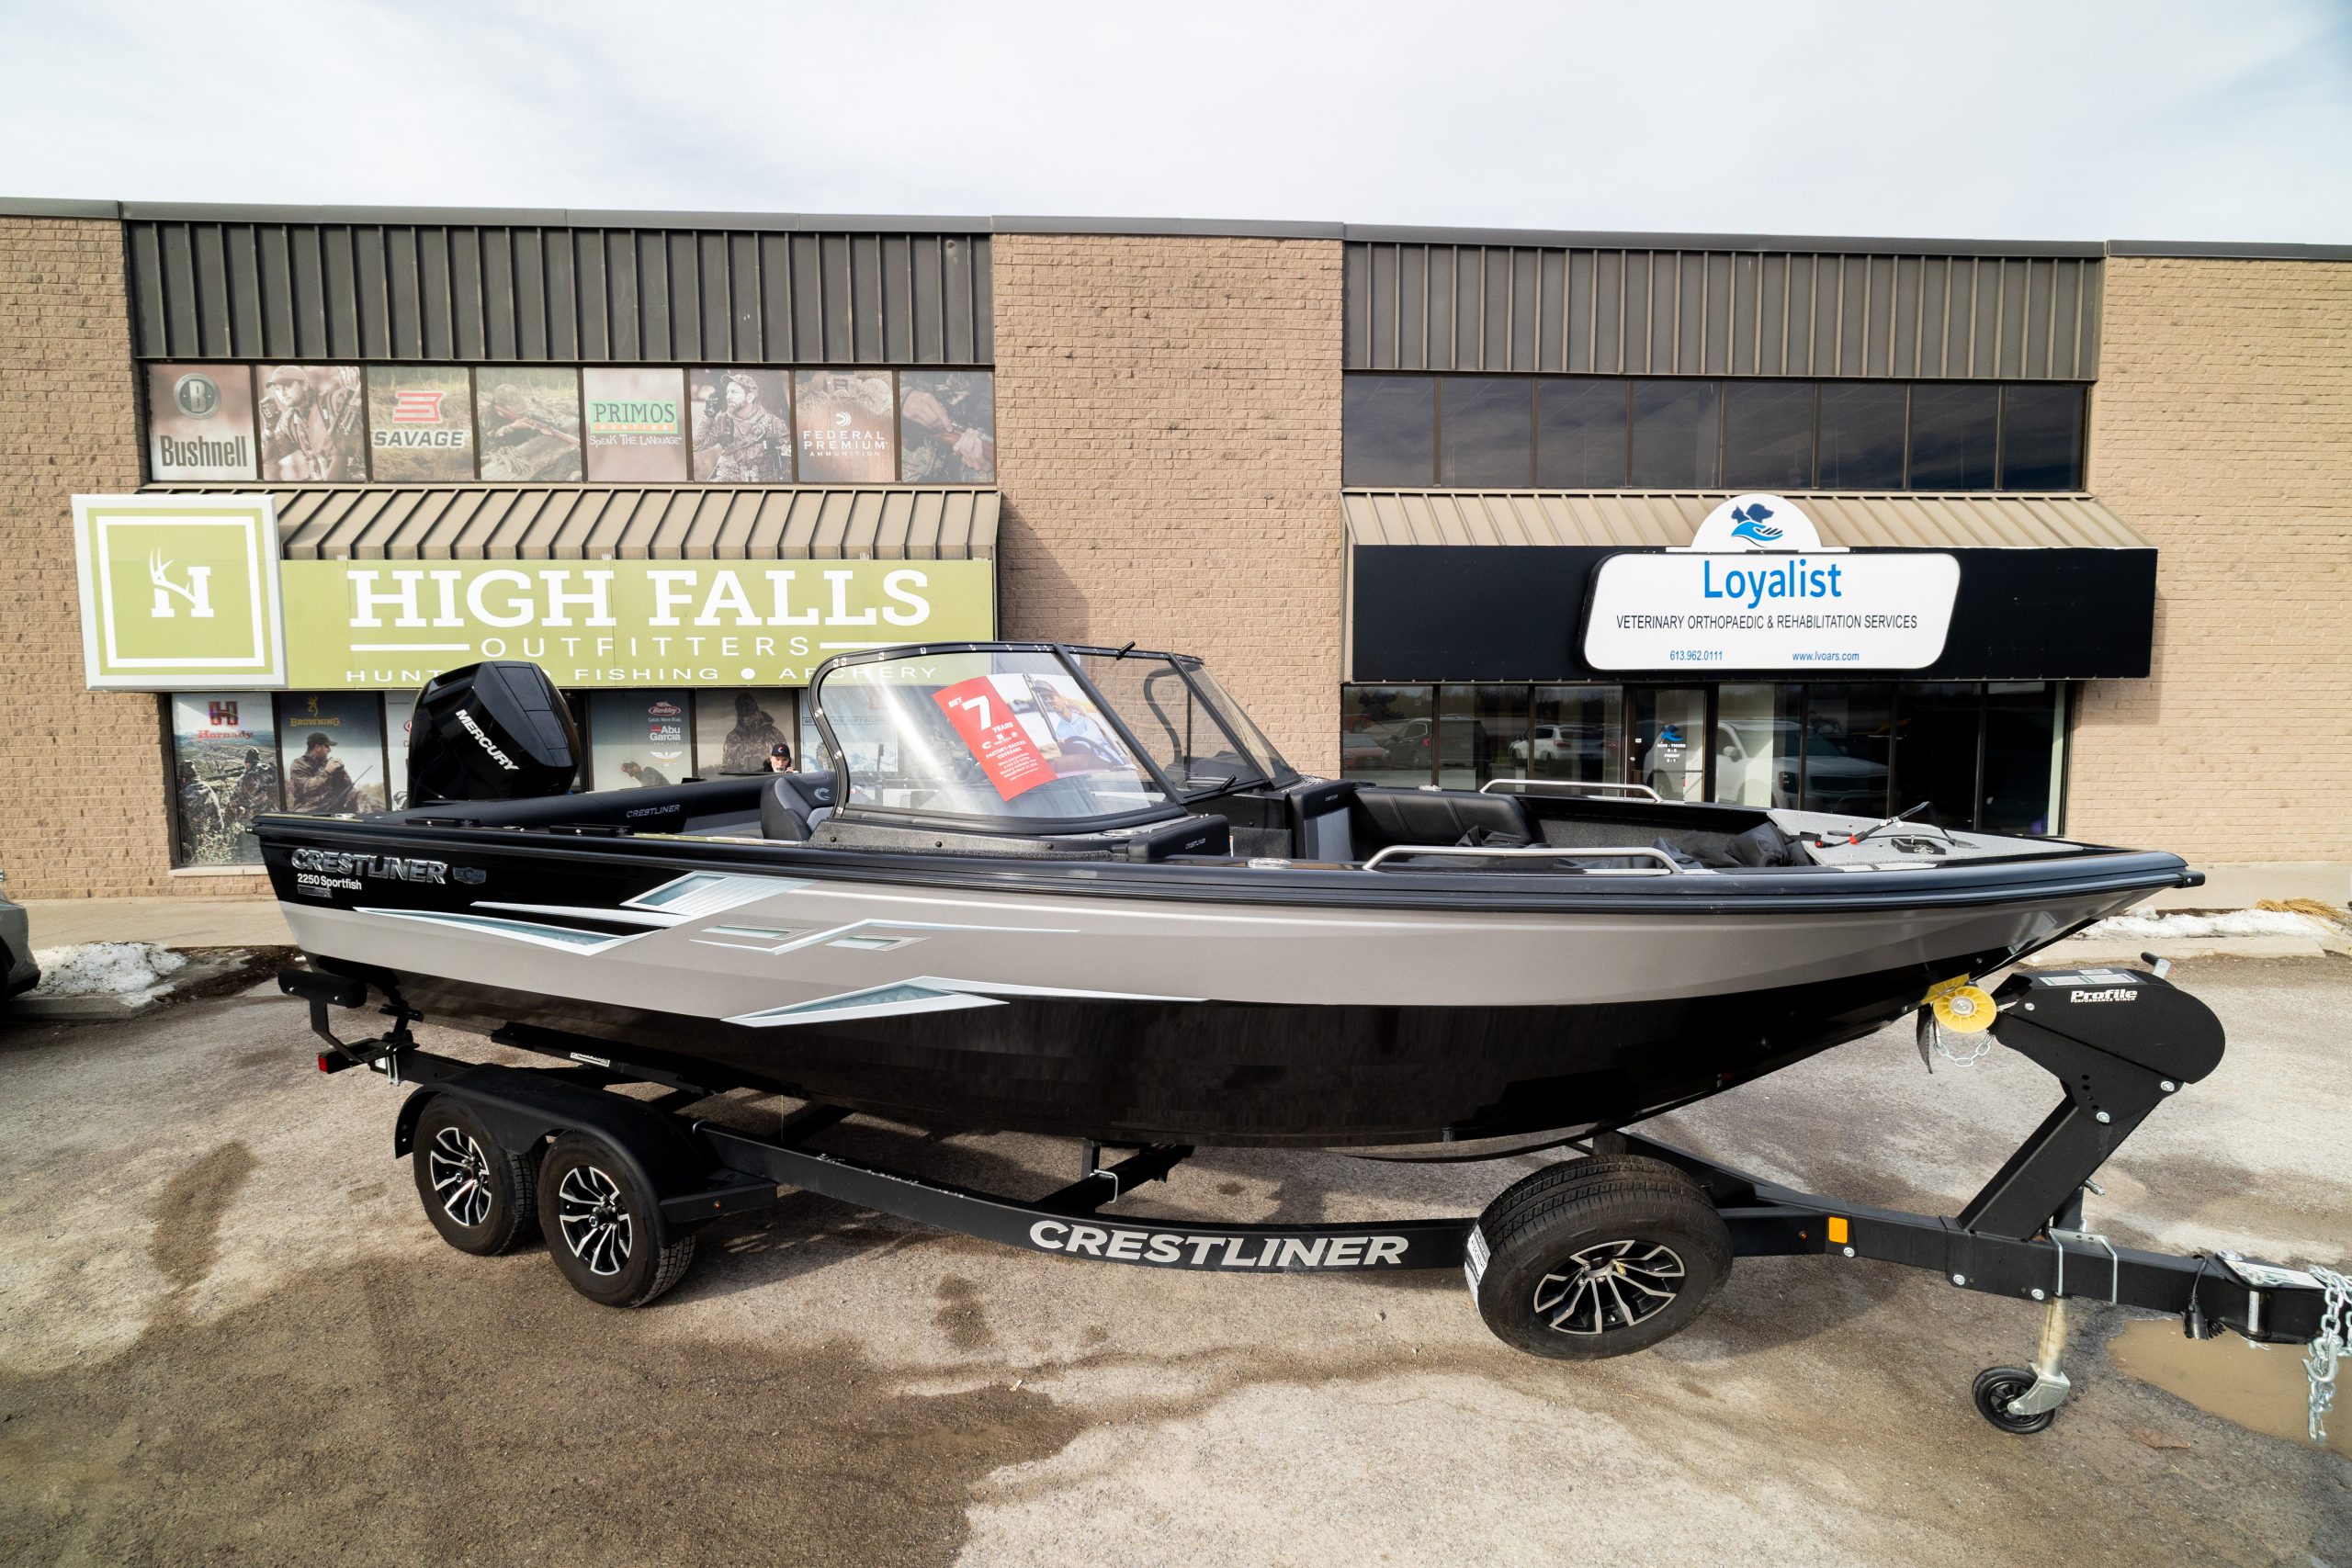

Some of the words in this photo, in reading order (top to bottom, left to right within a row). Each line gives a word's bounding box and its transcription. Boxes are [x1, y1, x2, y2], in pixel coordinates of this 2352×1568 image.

[593, 402, 675, 423] PRIMOS
[373, 431, 465, 446] SAVAGE
[803, 430, 886, 440] FEDERAL
[160, 434, 248, 468] Bushnell
[804, 440, 887, 450] PREMIUM
[1703, 558, 1842, 609] Loyalist
[346, 569, 617, 628] HIGH
[646, 569, 931, 626] FALLS
[1616, 615, 1685, 629] VETERINARY
[1687, 615, 1765, 629] ORTHOPAEDIC
[1767, 615, 1774, 629] &
[1776, 615, 1862, 628] REHABILITATION
[1863, 615, 1918, 628] SERVICES
[481, 636, 810, 658] OUTFITTERS
[1669, 649, 1724, 661] 613.962.0111
[1792, 650, 1860, 661] www.lvoars.com
[574, 667, 719, 681] FISHING
[651, 705, 678, 715] Berkley
[961, 694, 992, 731] 7
[289, 717, 341, 727] BROWNING
[992, 721, 1014, 733] YEARS
[198, 728, 253, 739] Hornady
[650, 732, 681, 741] Garcia
[661, 725, 681, 734] Abu
[455, 708, 520, 771] MERCURY
[626, 804, 681, 818] CRESTLINER
[290, 848, 448, 885] CRESTLINER
[297, 873, 320, 886] 2250
[320, 874, 362, 891] Sportfish
[2071, 988, 2138, 1000] Profile
[1029, 1220, 1409, 1267] CRESTLINER
